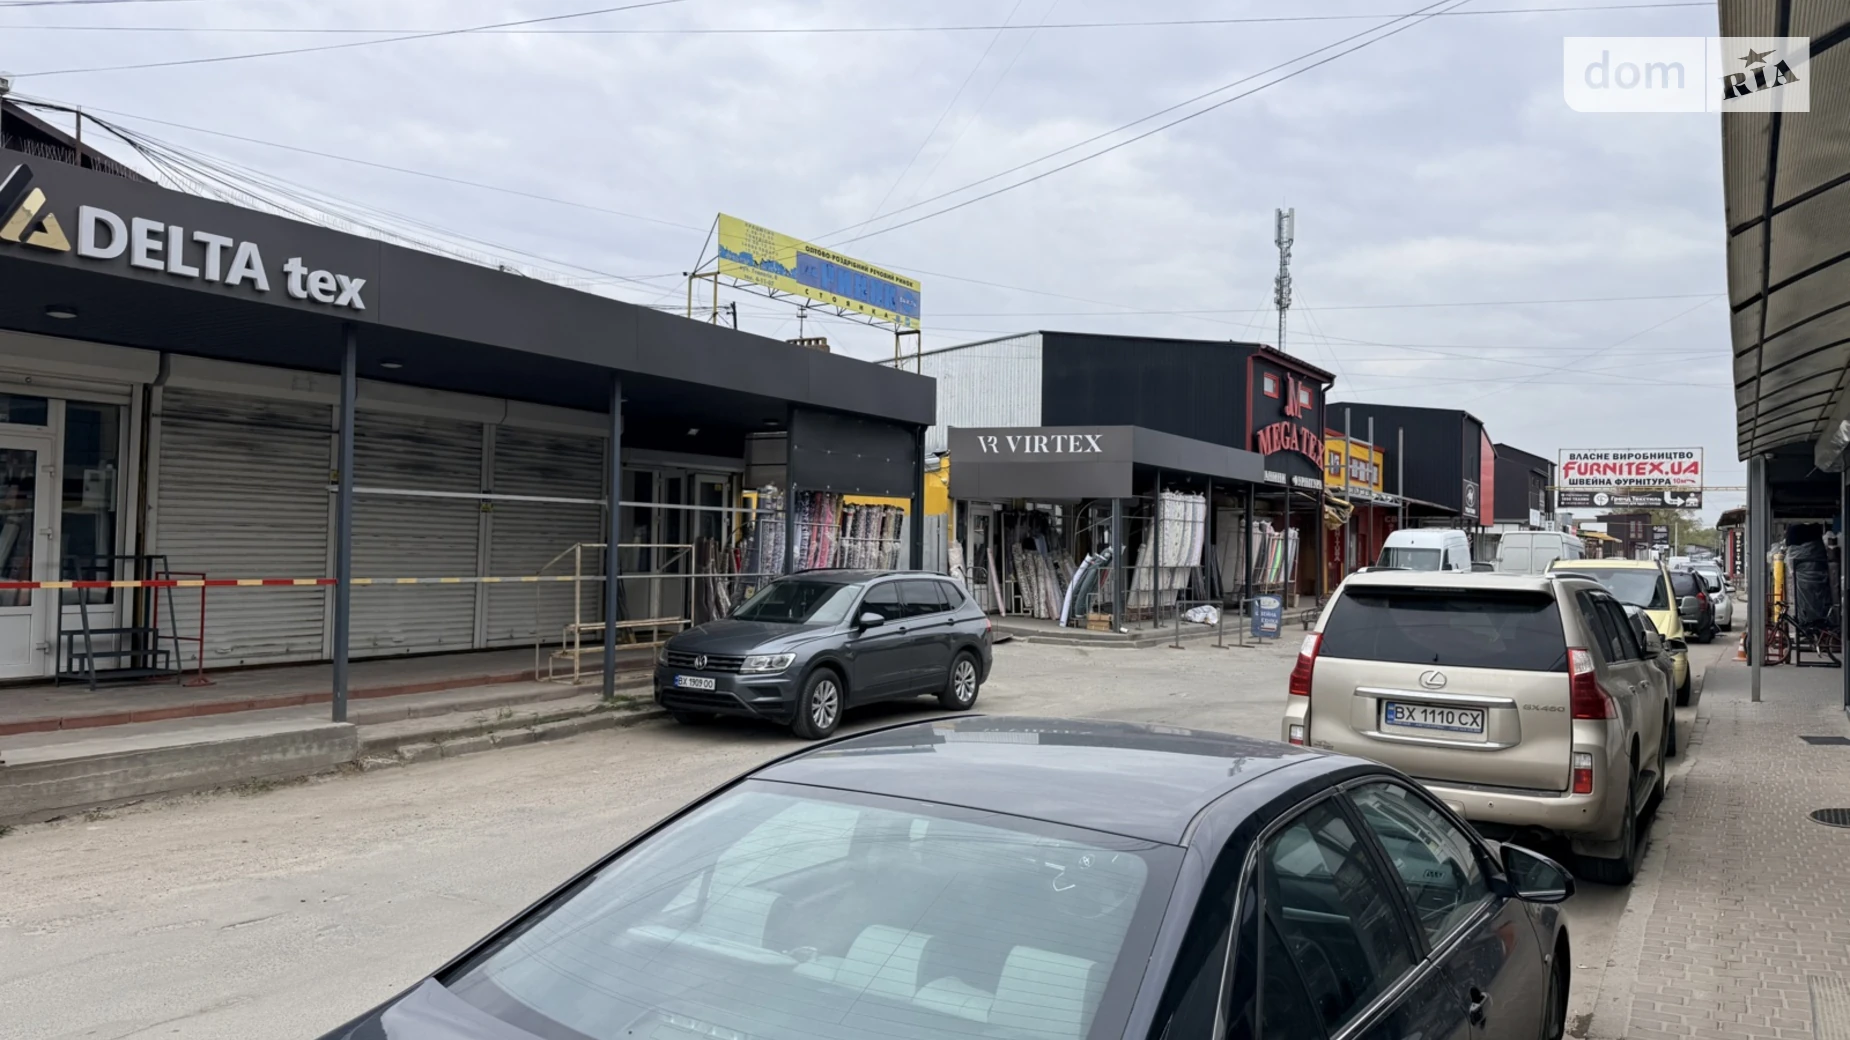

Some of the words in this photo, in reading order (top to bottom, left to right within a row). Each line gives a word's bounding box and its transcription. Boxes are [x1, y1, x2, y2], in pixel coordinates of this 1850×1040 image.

[77, 205, 270, 291] DELTA
[283, 257, 366, 310] tex
[805, 246, 869, 272] ОПТОВО-РОЗДРІБНИЙ
[870, 267, 894, 281] РЕЧОВИЙ
[895, 276, 914, 288] РИНОК
[805, 288, 889, 318] СТОЯНКА
[1006, 434, 1103, 453] VIRTEX
[1257, 421, 1300, 456] MEGA
[1301, 426, 1325, 471] TEX
[1569, 452, 1610, 460] ВЛАСНЕ
[1612, 451, 1693, 461] ВИРОБНИЦТВО
[1563, 461, 1699, 479] FURNITEX.UA
[1568, 477, 1612, 486] ШВЕЙНА
[1614, 478, 1671, 486] ФУРНІТУРА
[1395, 706, 1416, 721] BX
[1420, 708, 1454, 724] 1110
[1458, 712, 1481, 728] CX
